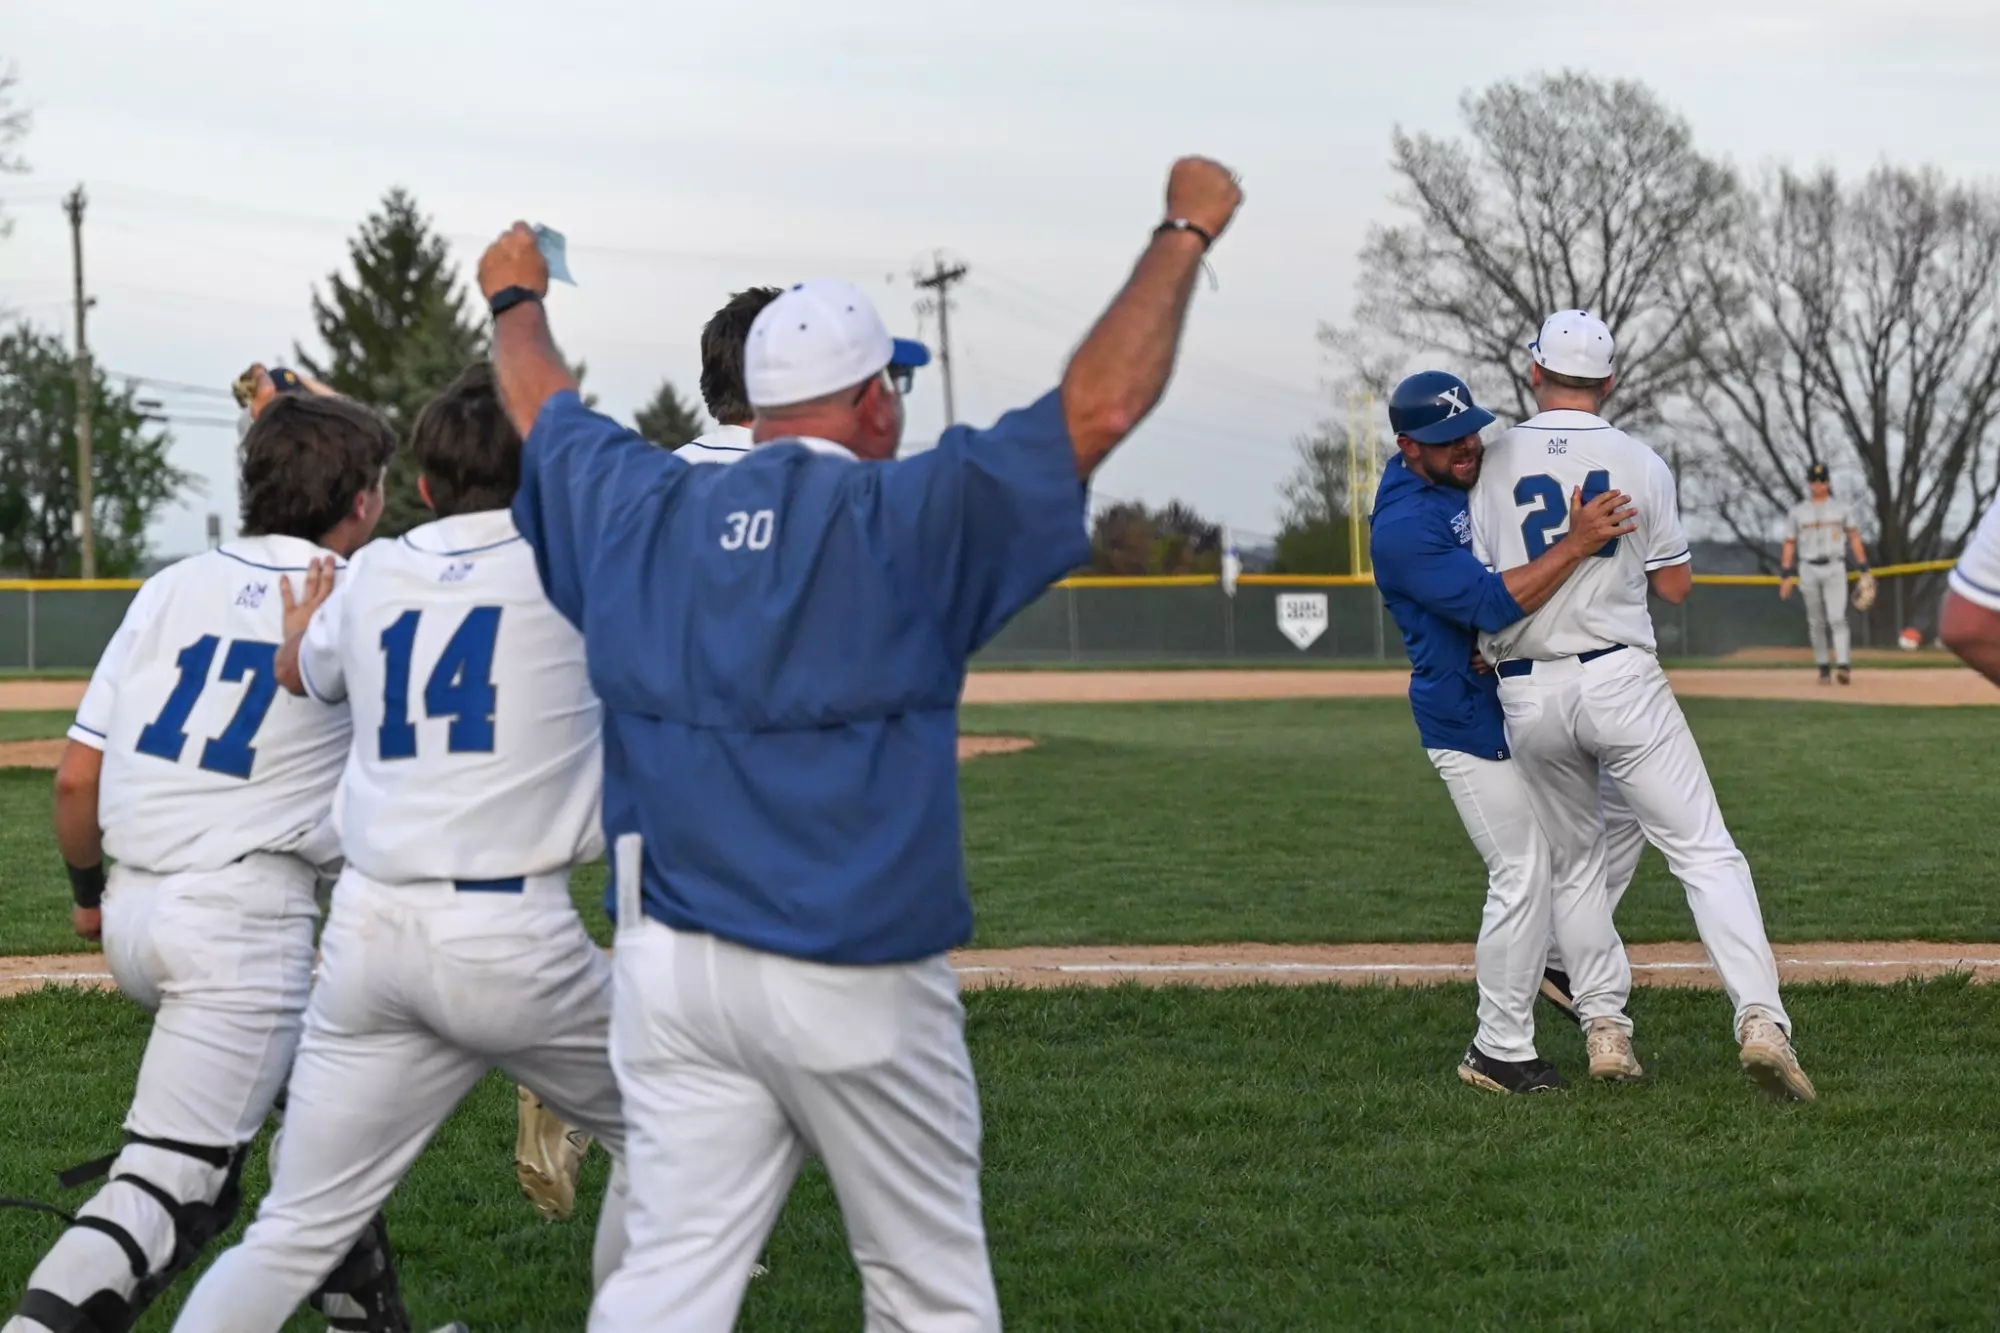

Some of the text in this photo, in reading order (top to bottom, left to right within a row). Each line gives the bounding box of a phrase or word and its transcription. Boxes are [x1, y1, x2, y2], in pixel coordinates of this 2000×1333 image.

[1438, 386, 1469, 418] X
[720, 509, 774, 551] 30
[135, 633, 279, 780] 17
[378, 605, 504, 760] 14
